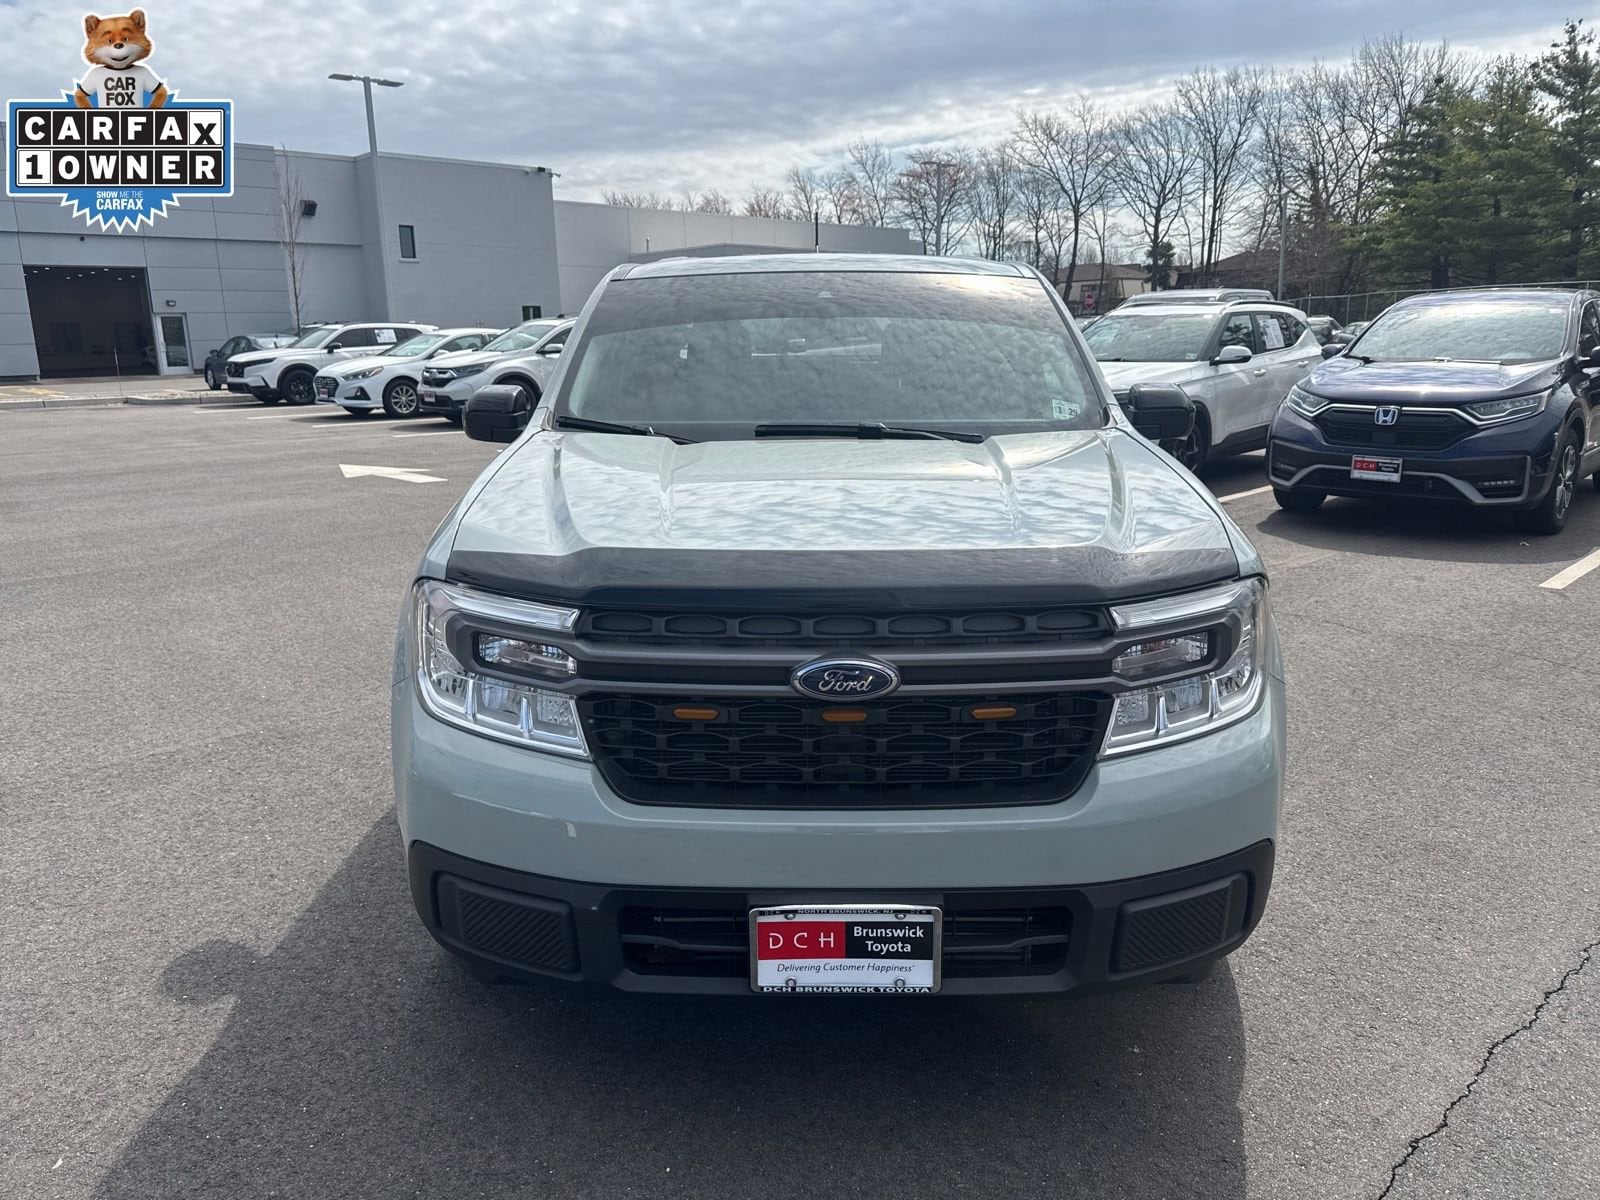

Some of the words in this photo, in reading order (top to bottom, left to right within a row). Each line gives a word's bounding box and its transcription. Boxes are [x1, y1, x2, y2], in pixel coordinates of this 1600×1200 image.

[818, 669, 873, 692] Ford
[853, 926, 924, 938] Brunswick
[768, 932, 834, 949] DCH
[865, 941, 912, 955] Toyota
[777, 963, 821, 974] Delivering
[823, 963, 865, 972] Customer
